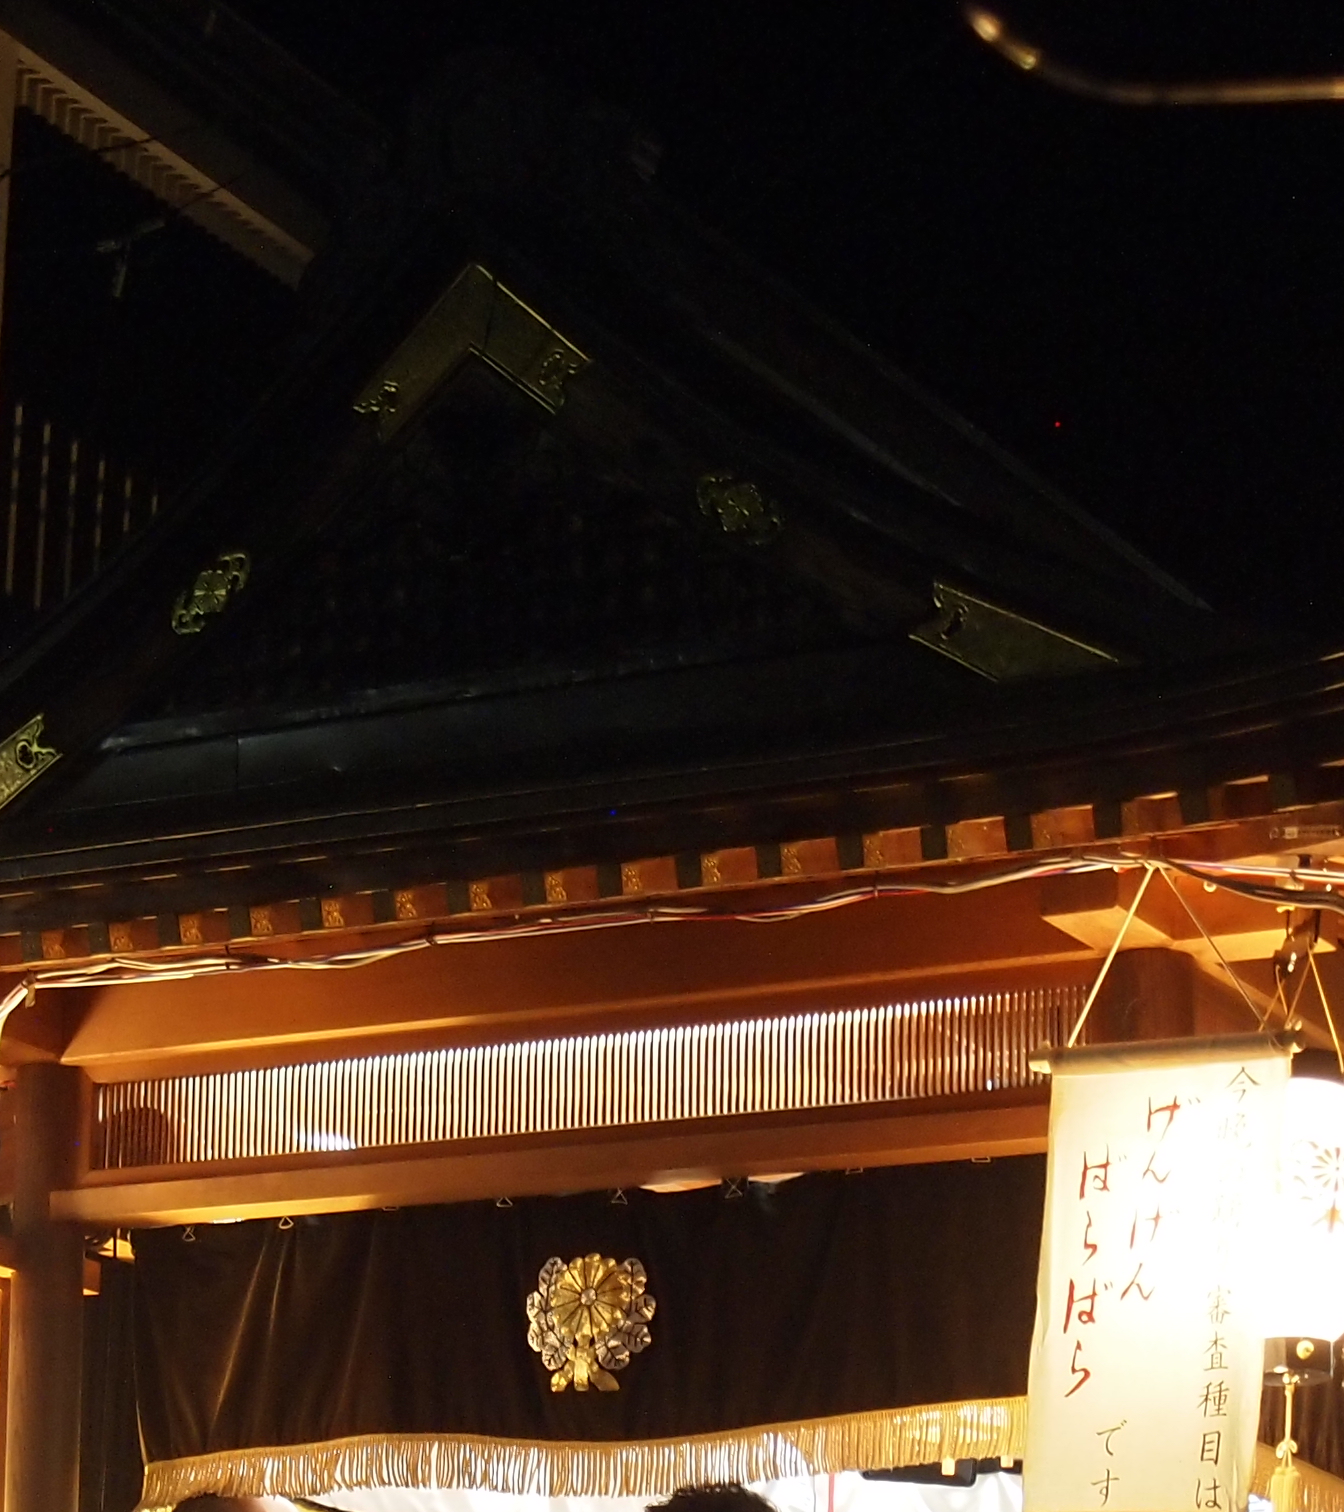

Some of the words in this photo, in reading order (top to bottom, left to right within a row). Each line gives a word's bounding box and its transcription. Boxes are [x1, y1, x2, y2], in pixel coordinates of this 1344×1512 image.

[1063, 1143, 1128, 1398] ばらばら
[1121, 1095, 1202, 1301] げんげん
[1091, 1420, 1127, 1507] です
